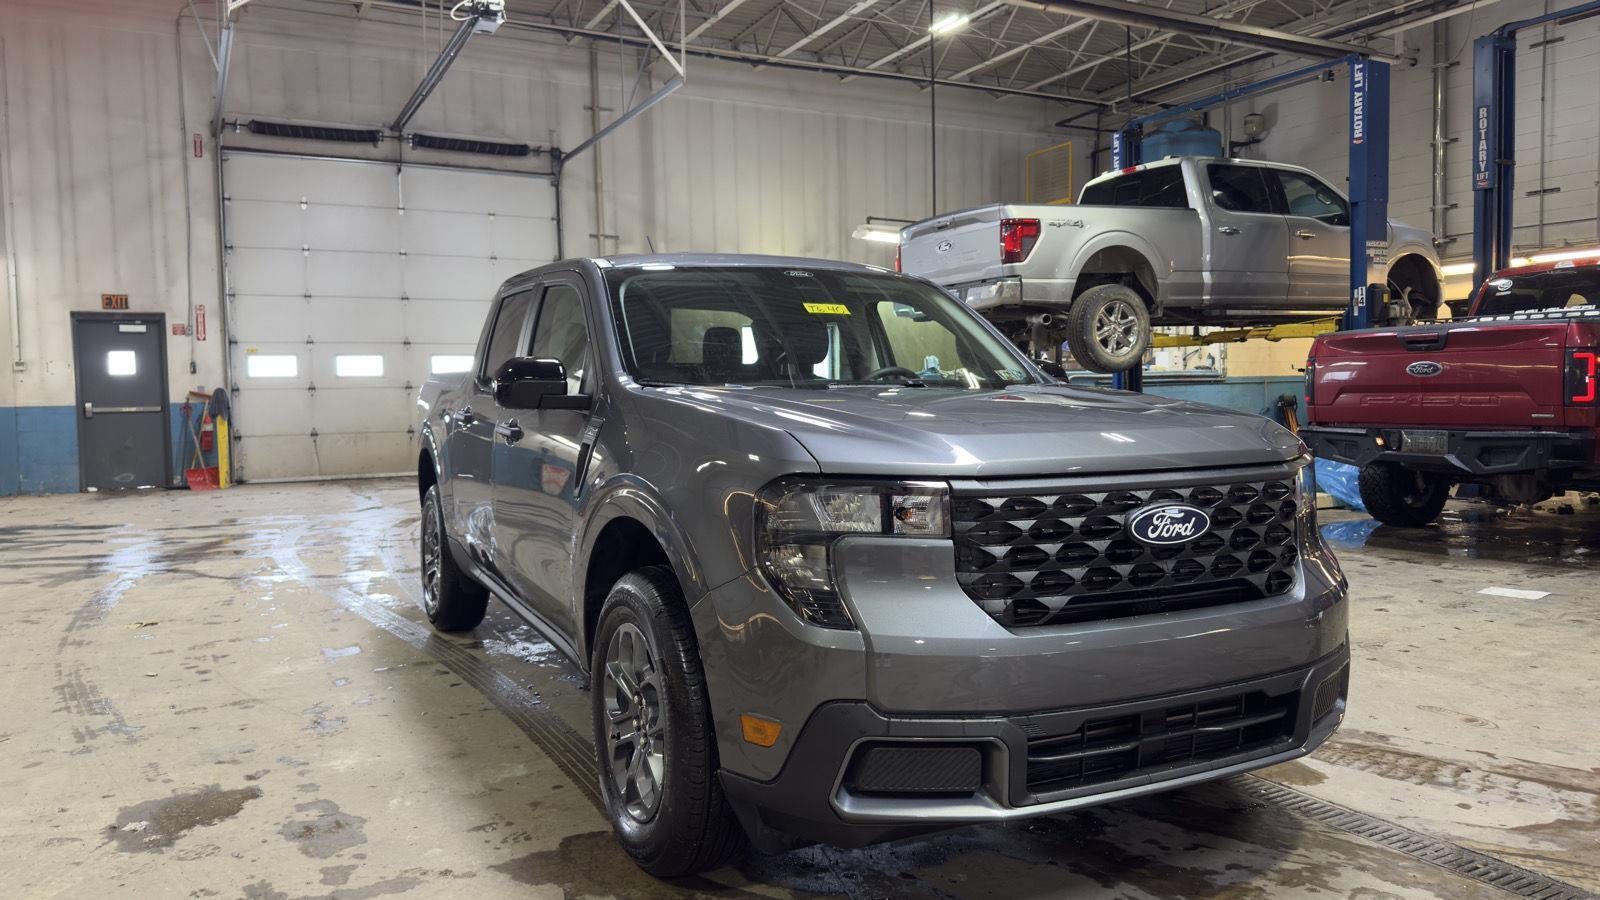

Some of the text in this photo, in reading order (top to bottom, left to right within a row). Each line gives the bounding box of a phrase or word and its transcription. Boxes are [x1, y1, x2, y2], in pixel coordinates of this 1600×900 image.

[1353, 63, 1364, 138] ROTARY LIFT
[1476, 107, 1489, 180] ROTARY LIFT
[103, 295, 128, 309] EXIT
[1147, 509, 1196, 539] Ford
